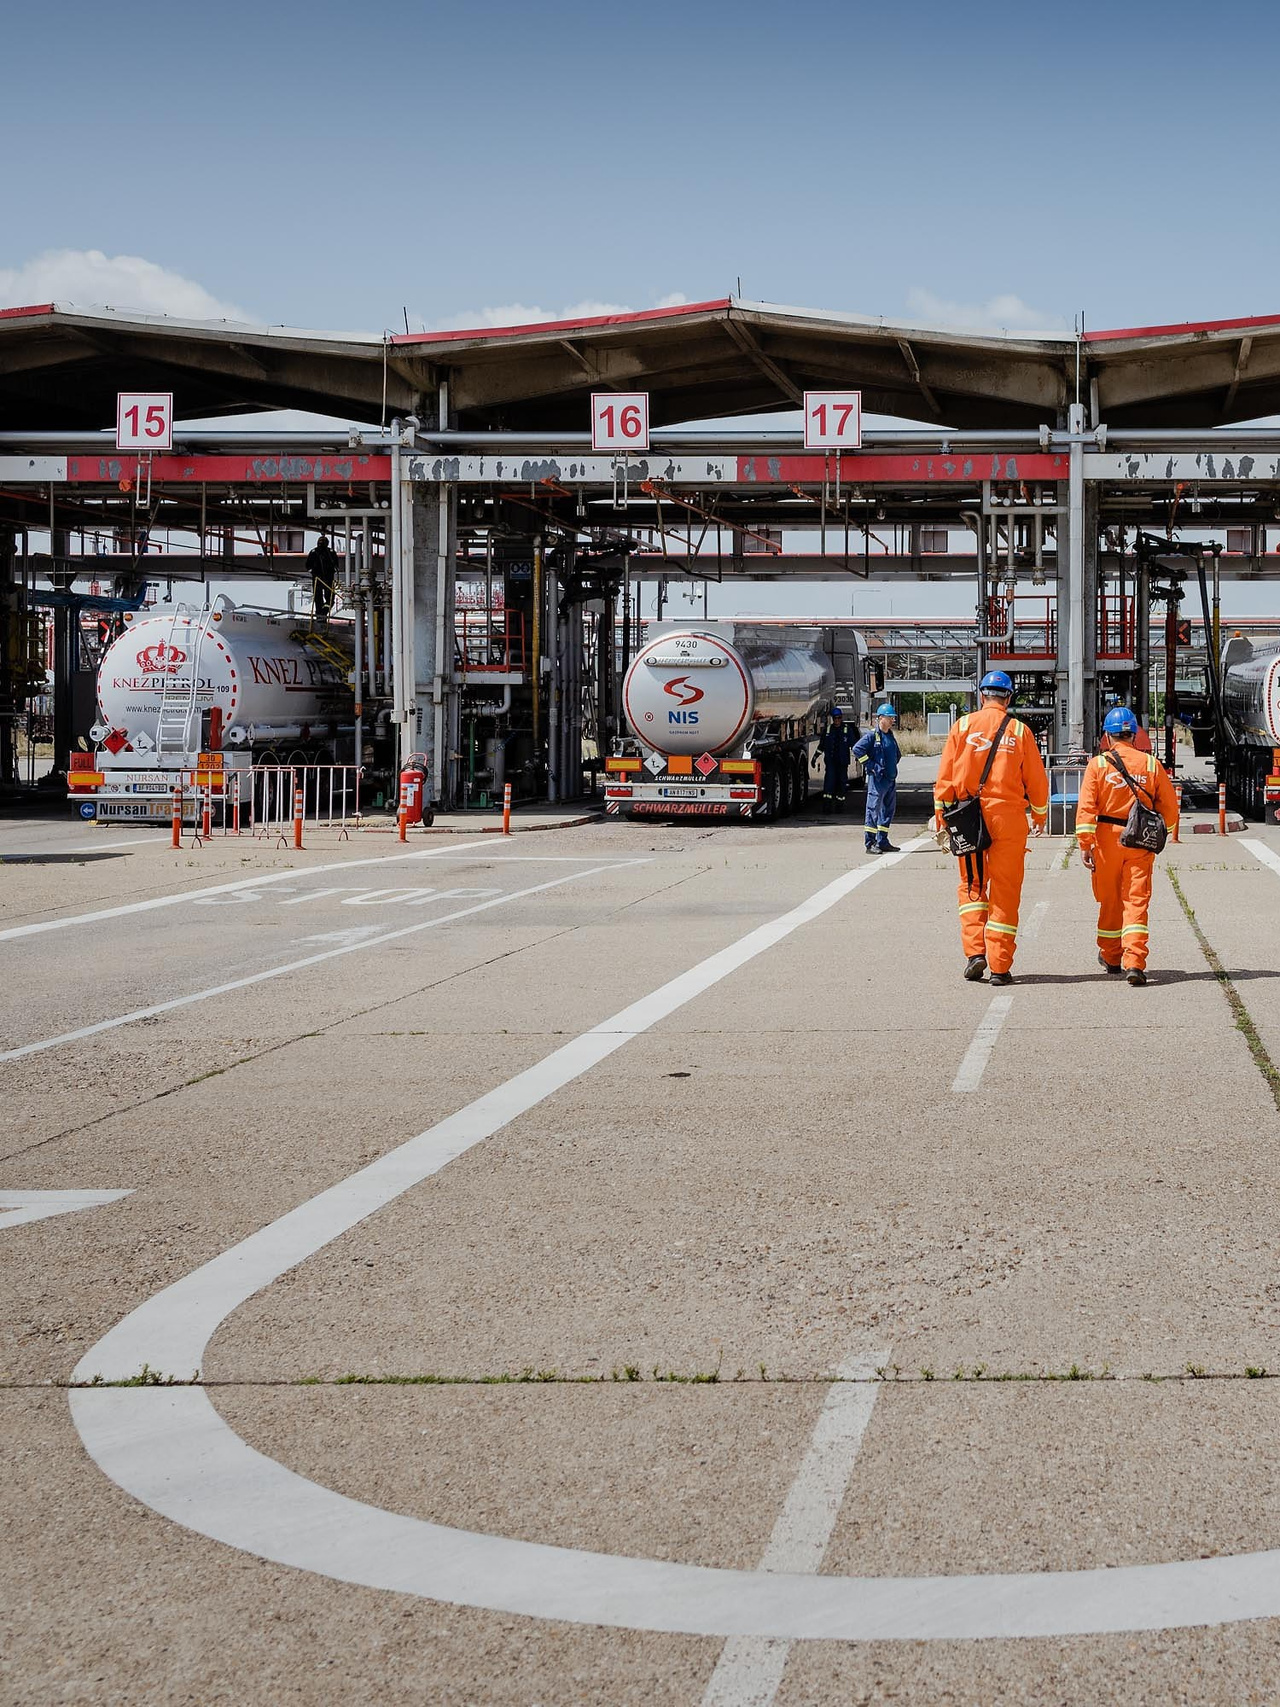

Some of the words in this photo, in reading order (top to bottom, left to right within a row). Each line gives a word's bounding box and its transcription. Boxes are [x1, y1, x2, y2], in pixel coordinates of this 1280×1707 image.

[124, 405, 165, 438] 15
[599, 405, 642, 438] 16
[812, 403, 853, 436] 17
[675, 640, 698, 649] 9430
[247, 656, 303, 685] KNEZ
[217, 685, 230, 693] 109
[668, 711, 699, 724] NIS
[73, 757, 92, 769] FULL
[205, 754, 216, 762] 30
[126, 774, 169, 782] NURSAN
[99, 803, 148, 816] Nursan
[149, 803, 196, 816] Traer
[633, 803, 728, 814] SCHWARZMÜLLER
[192, 888, 503, 904] STOP
